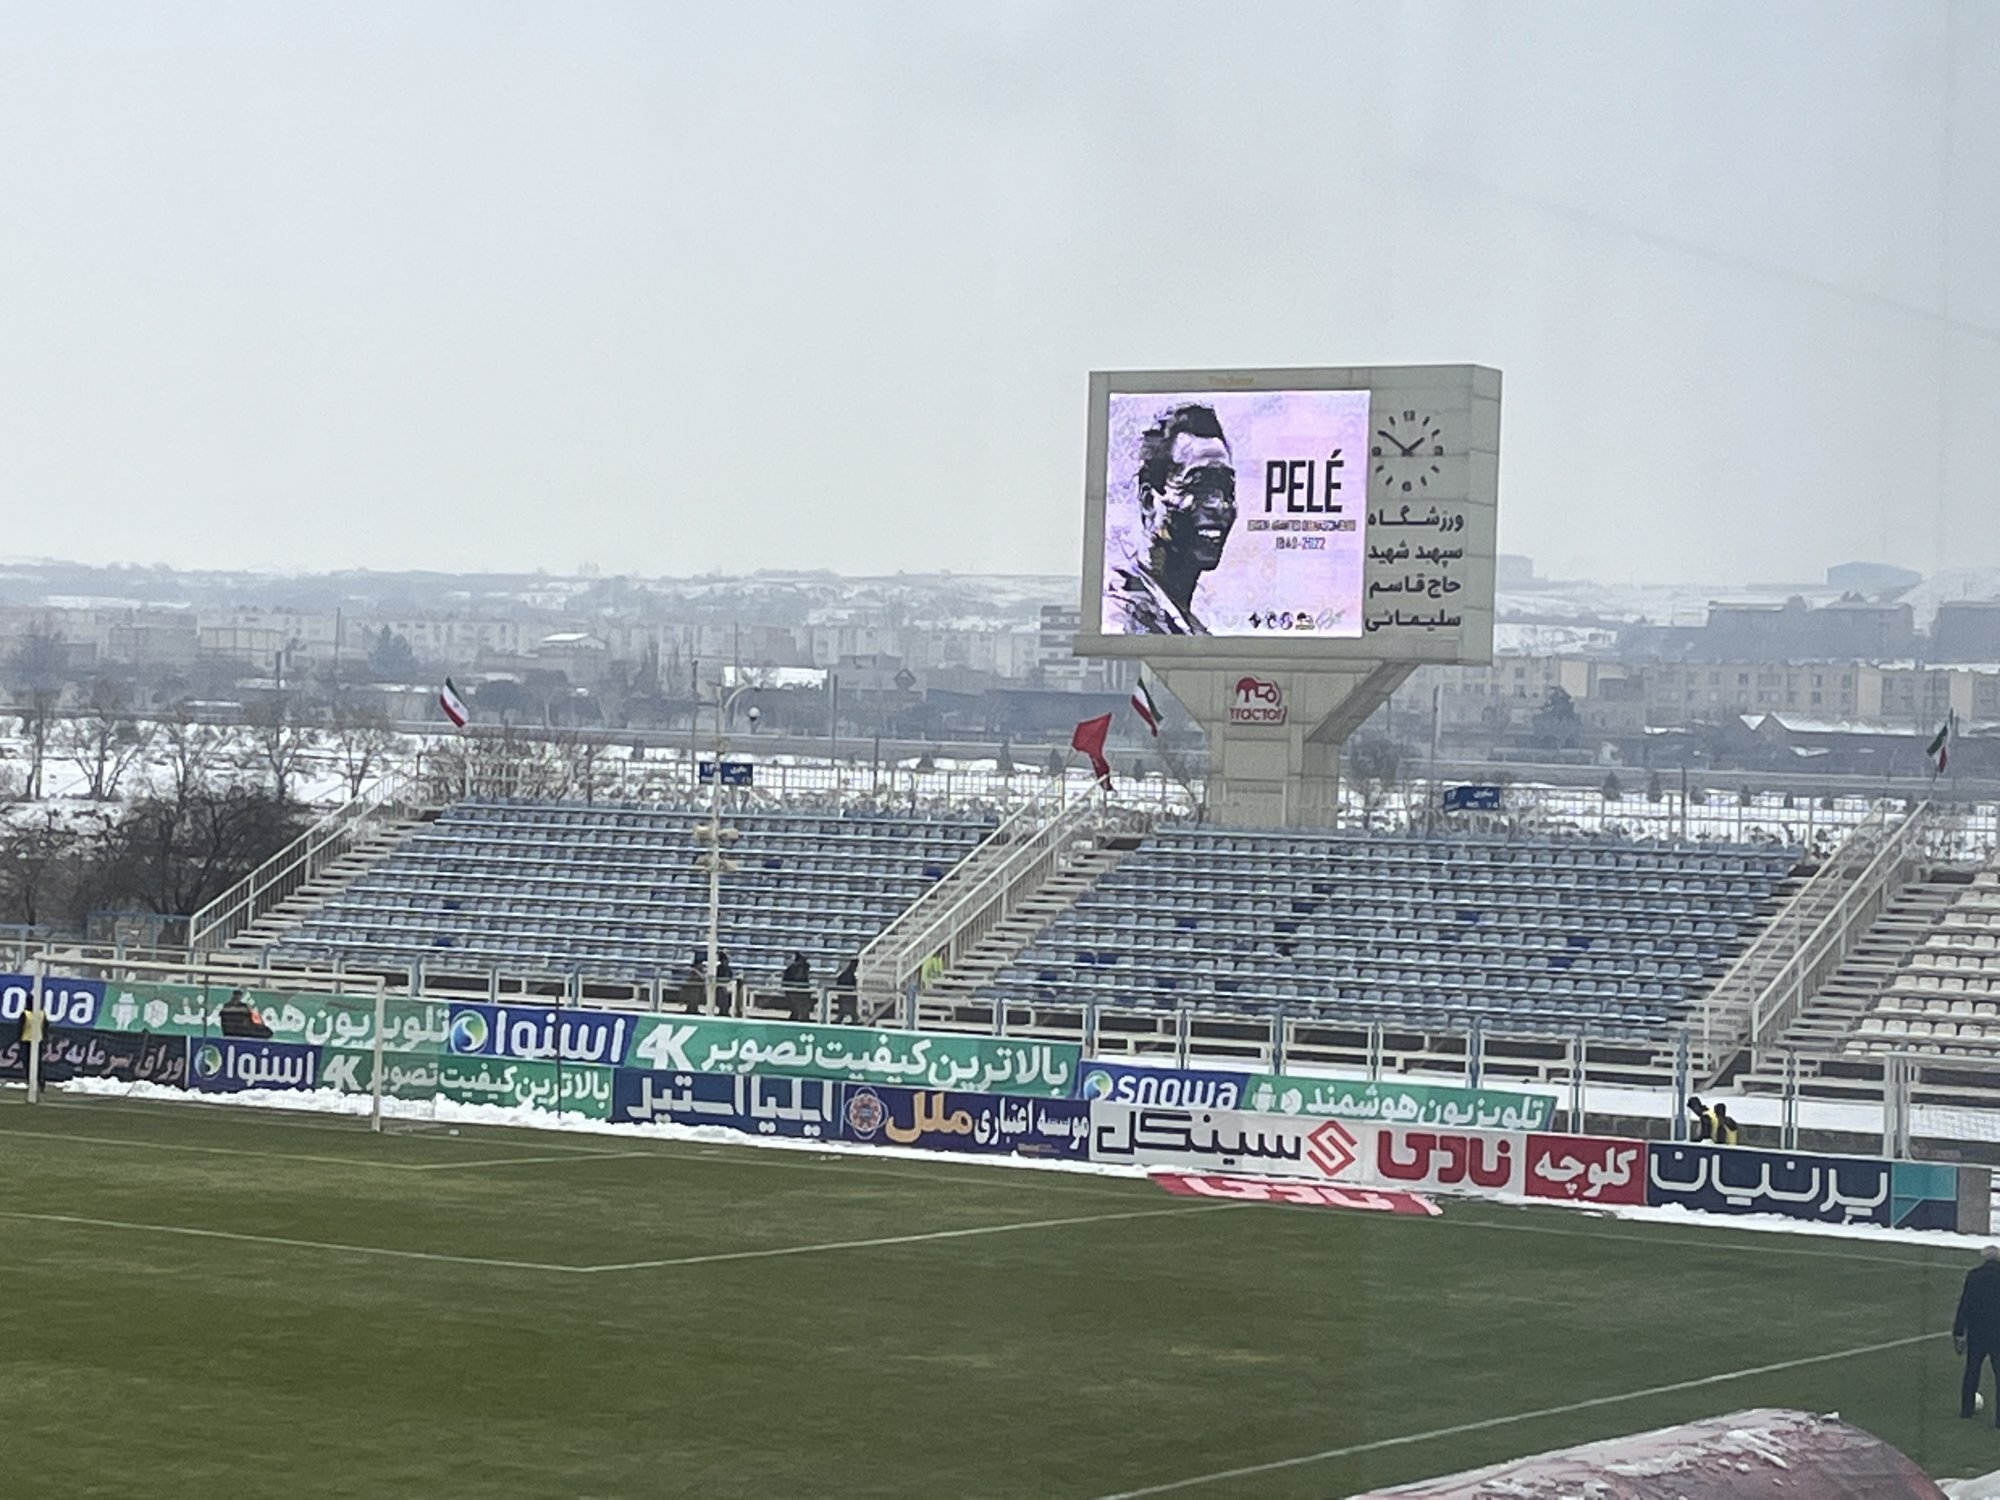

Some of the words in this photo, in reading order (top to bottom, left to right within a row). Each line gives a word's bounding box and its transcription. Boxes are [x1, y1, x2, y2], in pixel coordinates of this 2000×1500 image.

[1265, 449, 1345, 513] PELÉ
[1368, 505, 1464, 532] ورزشگاه
[1368, 540, 1409, 564] شهید
[1415, 544, 1463, 567] سپهبد
[1369, 573, 1425, 599] قاسم
[1427, 575, 1461, 599] حاج
[1365, 609, 1461, 631] سلیمانی
[495, 1010, 626, 1062] اسنوا
[636, 1023, 698, 1072] 4K
[701, 1033, 815, 1074] تصویر
[226, 1045, 315, 1088] اسنوا
[322, 1055, 363, 1091] 4K
[815, 1034, 931, 1083] کیفیت
[929, 1045, 1069, 1098] بالاترین
[439, 1063, 518, 1099] کیفیت
[515, 1071, 610, 1108] بالاترین
[626, 1074, 744, 1123] استیل
[1115, 1075, 1239, 1110] snowa
[885, 1092, 973, 1143] ملل
[1305, 1084, 1418, 1122] هوشمند
[1534, 1147, 1638, 1197] کلوچه
[1650, 1151, 1888, 1216] پرنیان
